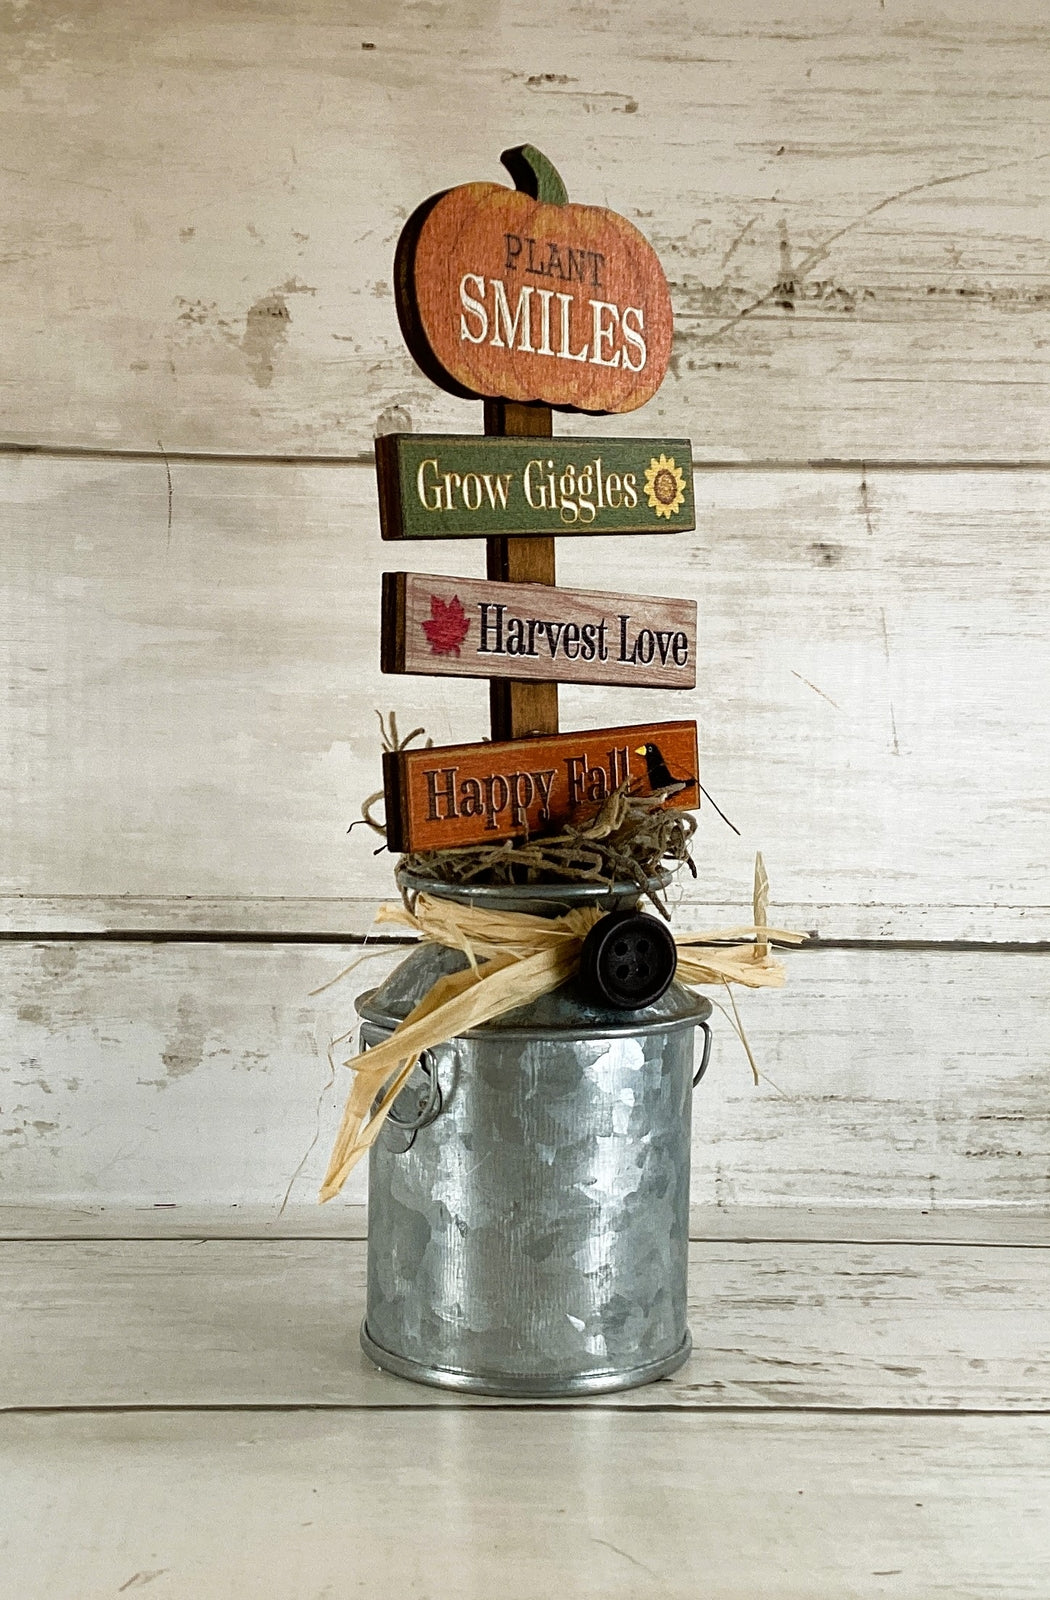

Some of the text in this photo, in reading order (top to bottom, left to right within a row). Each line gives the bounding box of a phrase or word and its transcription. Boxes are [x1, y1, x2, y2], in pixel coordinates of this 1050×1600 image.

[503, 233, 605, 287] PLANT
[459, 273, 647, 372] SMILES
[417, 457, 638, 523] Grow Giggles
[477, 602, 688, 667] Harvest Love
[422, 745, 632, 830] Happy Fall
